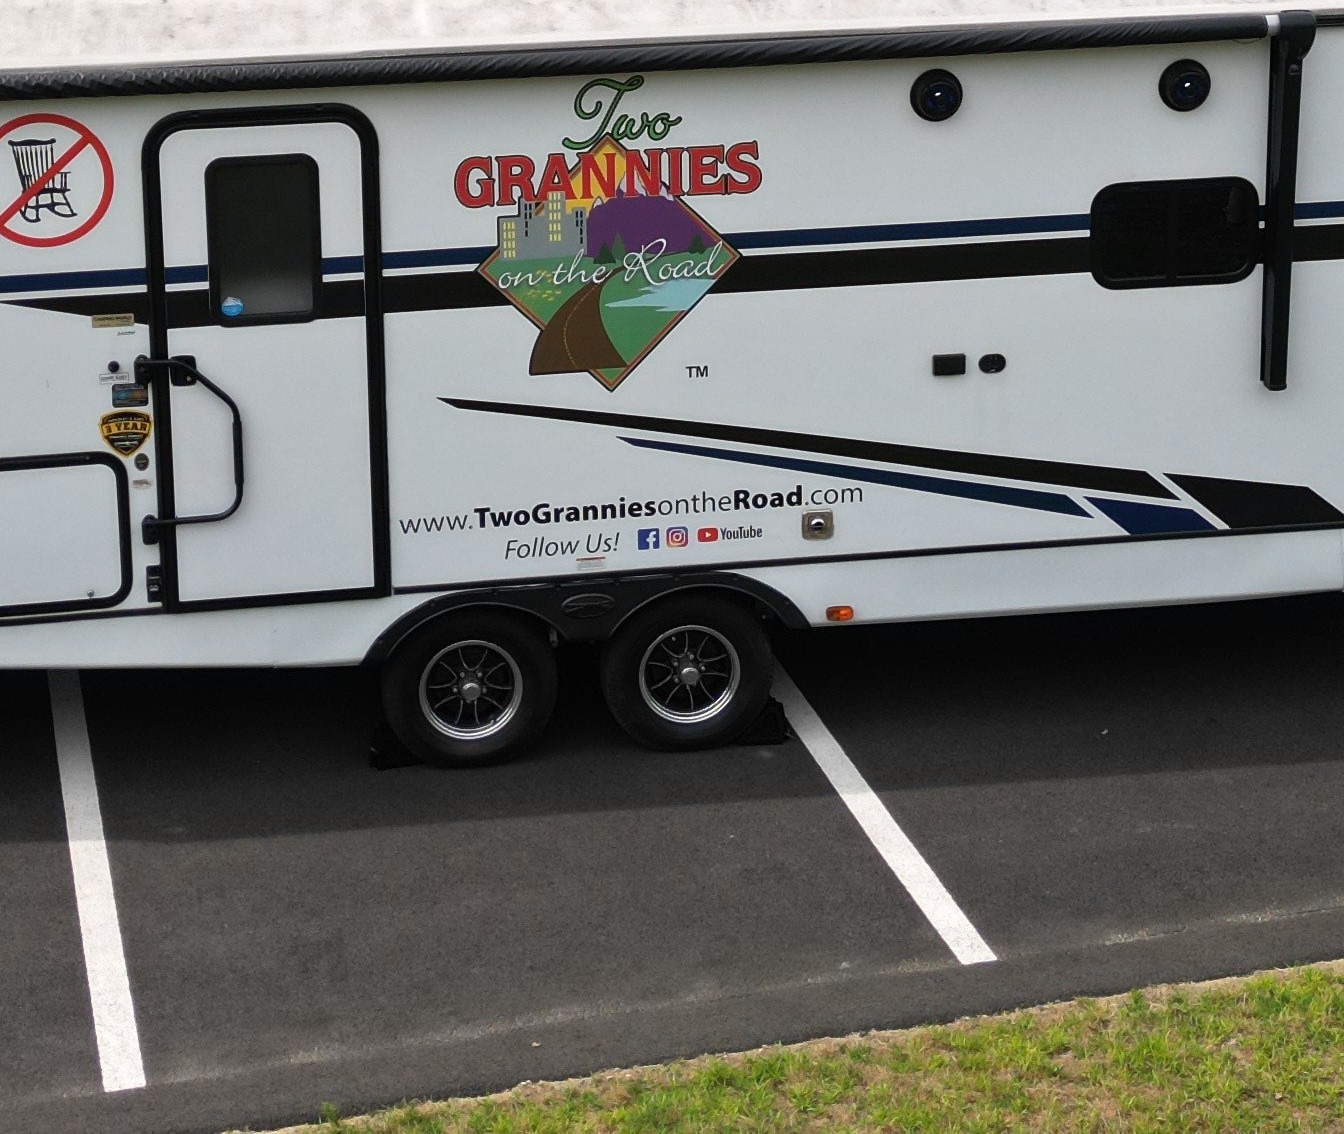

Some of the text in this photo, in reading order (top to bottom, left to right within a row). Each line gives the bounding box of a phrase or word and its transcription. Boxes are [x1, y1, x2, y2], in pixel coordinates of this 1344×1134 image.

[562, 75, 683, 151] Two
[454, 140, 763, 209] GRANNIES
[498, 238, 724, 290] on the Road
[685, 366, 709, 378] TM
[115, 421, 148, 432] YEAR
[399, 484, 863, 535] www.TwoGranniesontheRoad.com
[504, 535, 579, 560] Follow
[585, 531, 620, 553] Us!
[720, 525, 763, 541] YouTube
